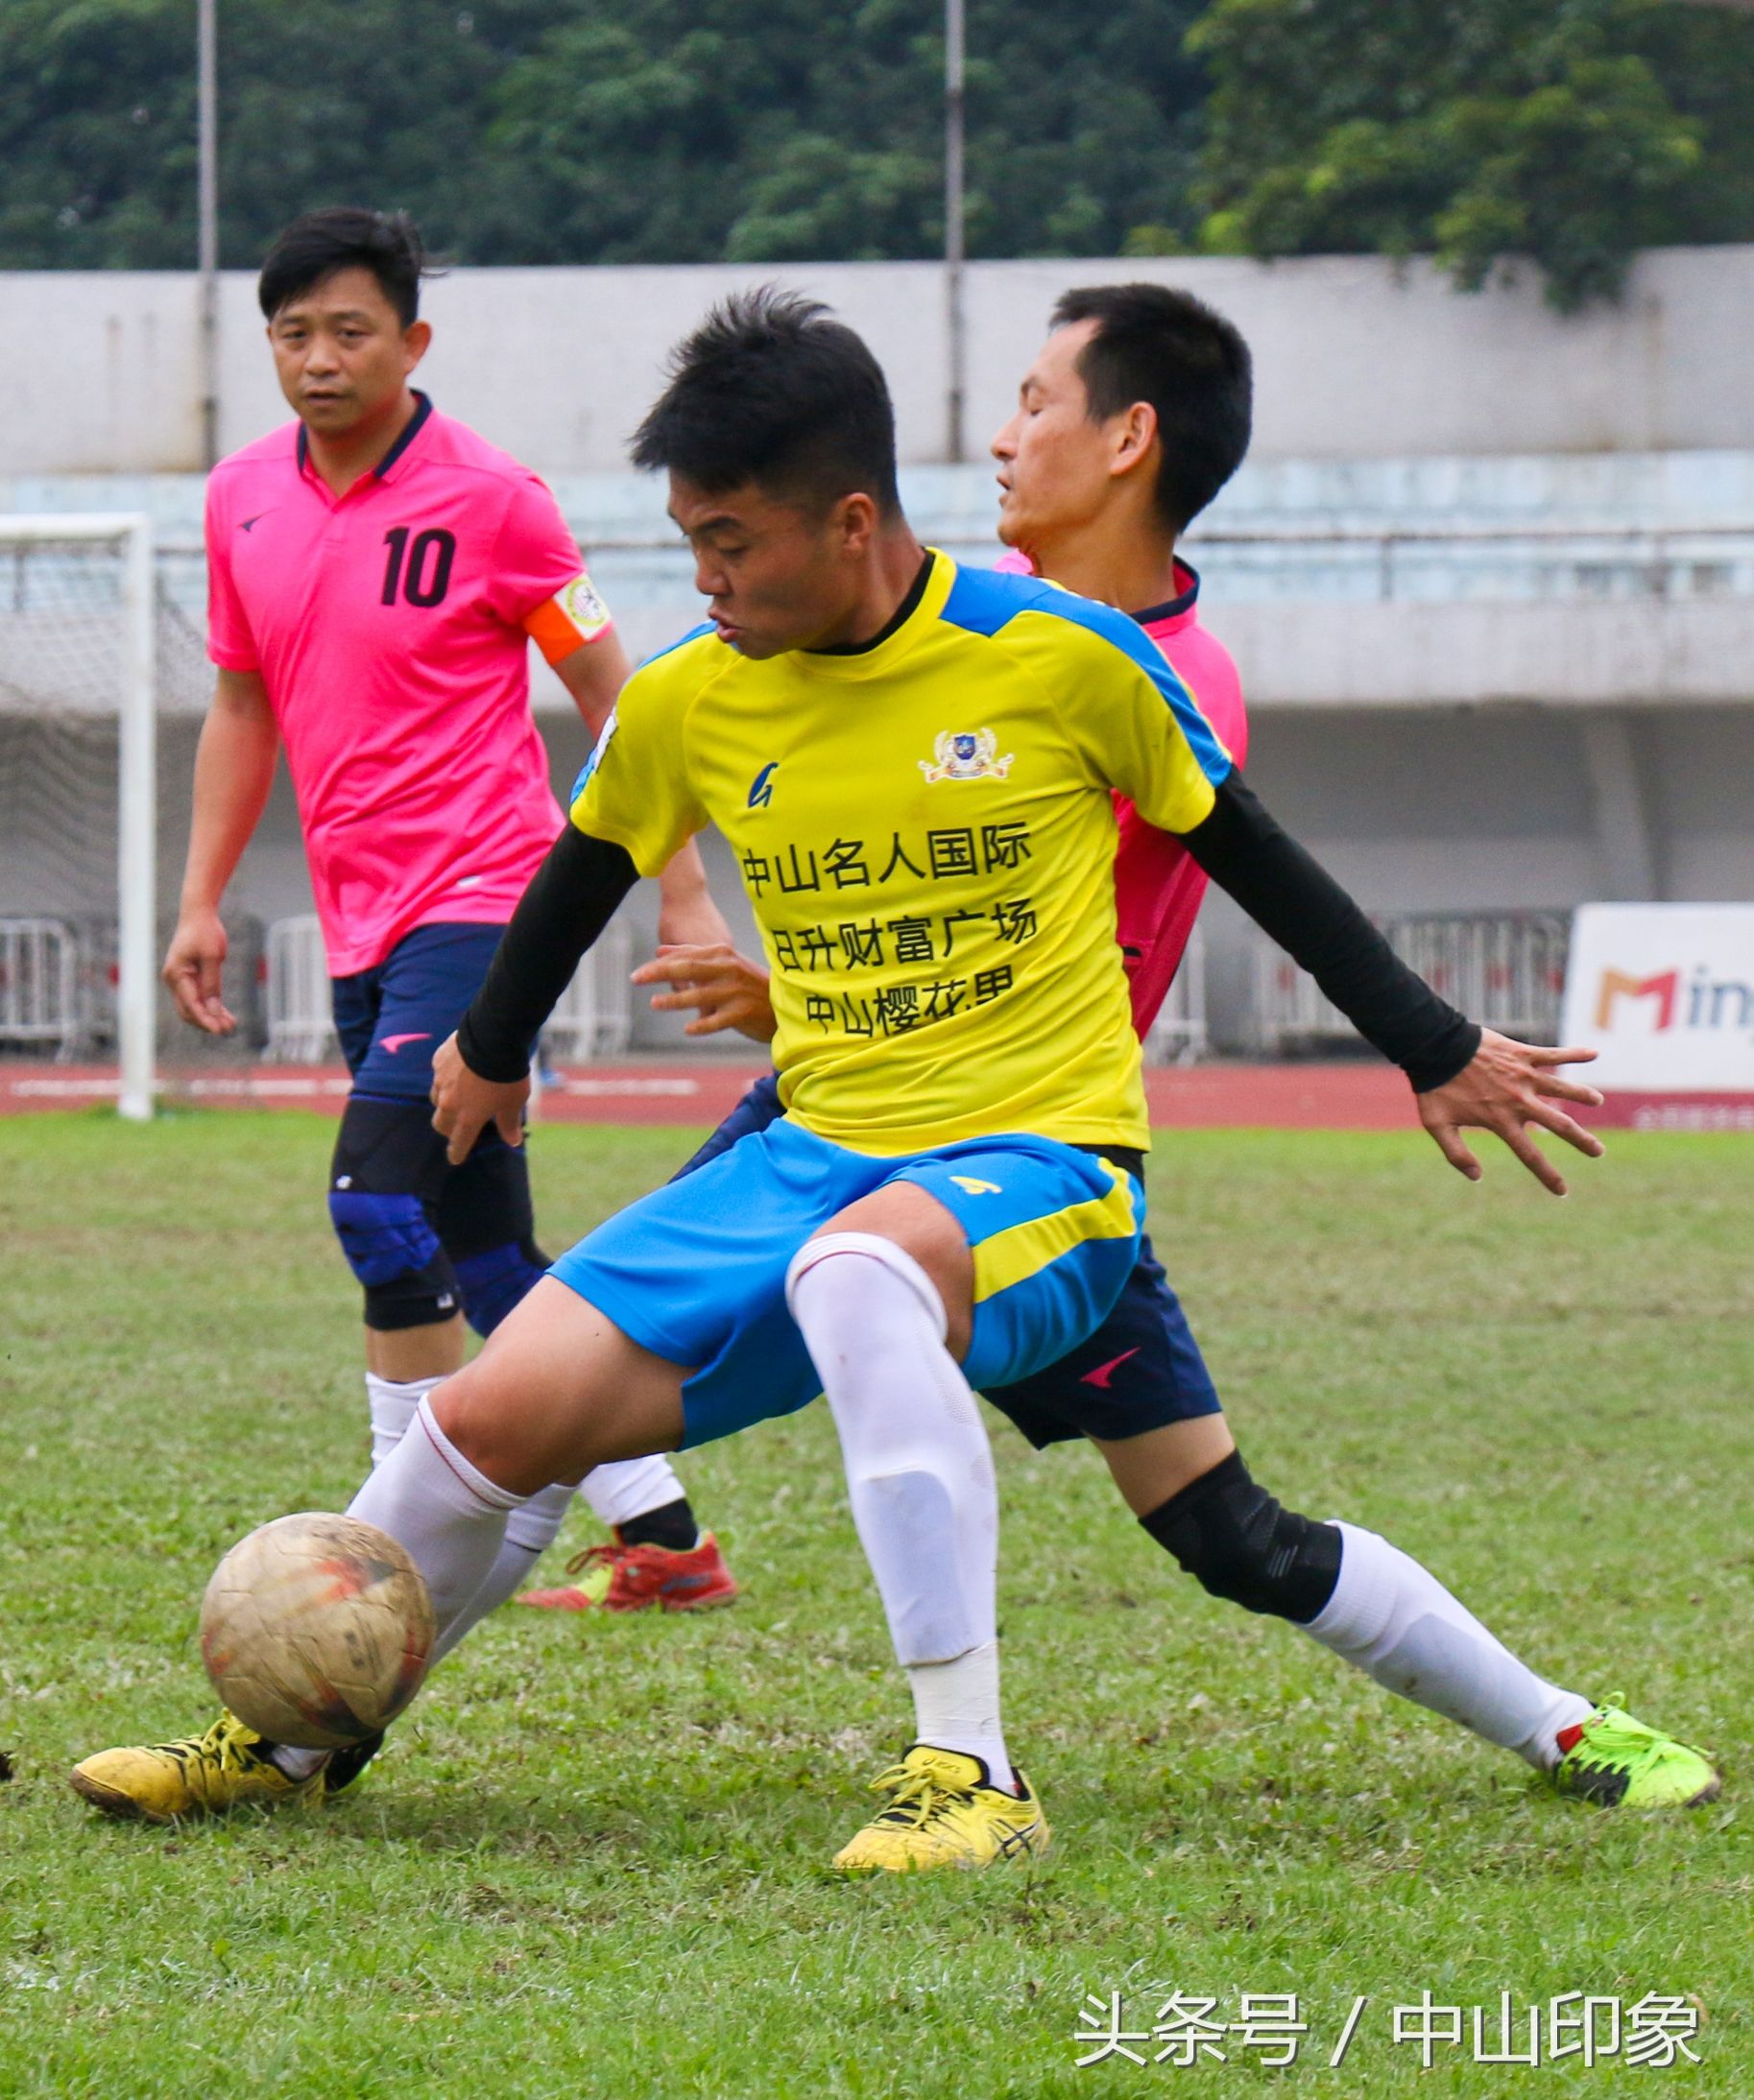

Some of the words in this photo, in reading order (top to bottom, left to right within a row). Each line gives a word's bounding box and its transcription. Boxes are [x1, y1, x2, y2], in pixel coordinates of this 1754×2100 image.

[381, 526, 456, 608] 10
[743, 822, 1031, 897] 中山名人国际
[772, 898, 1037, 972] 日升财富广场
